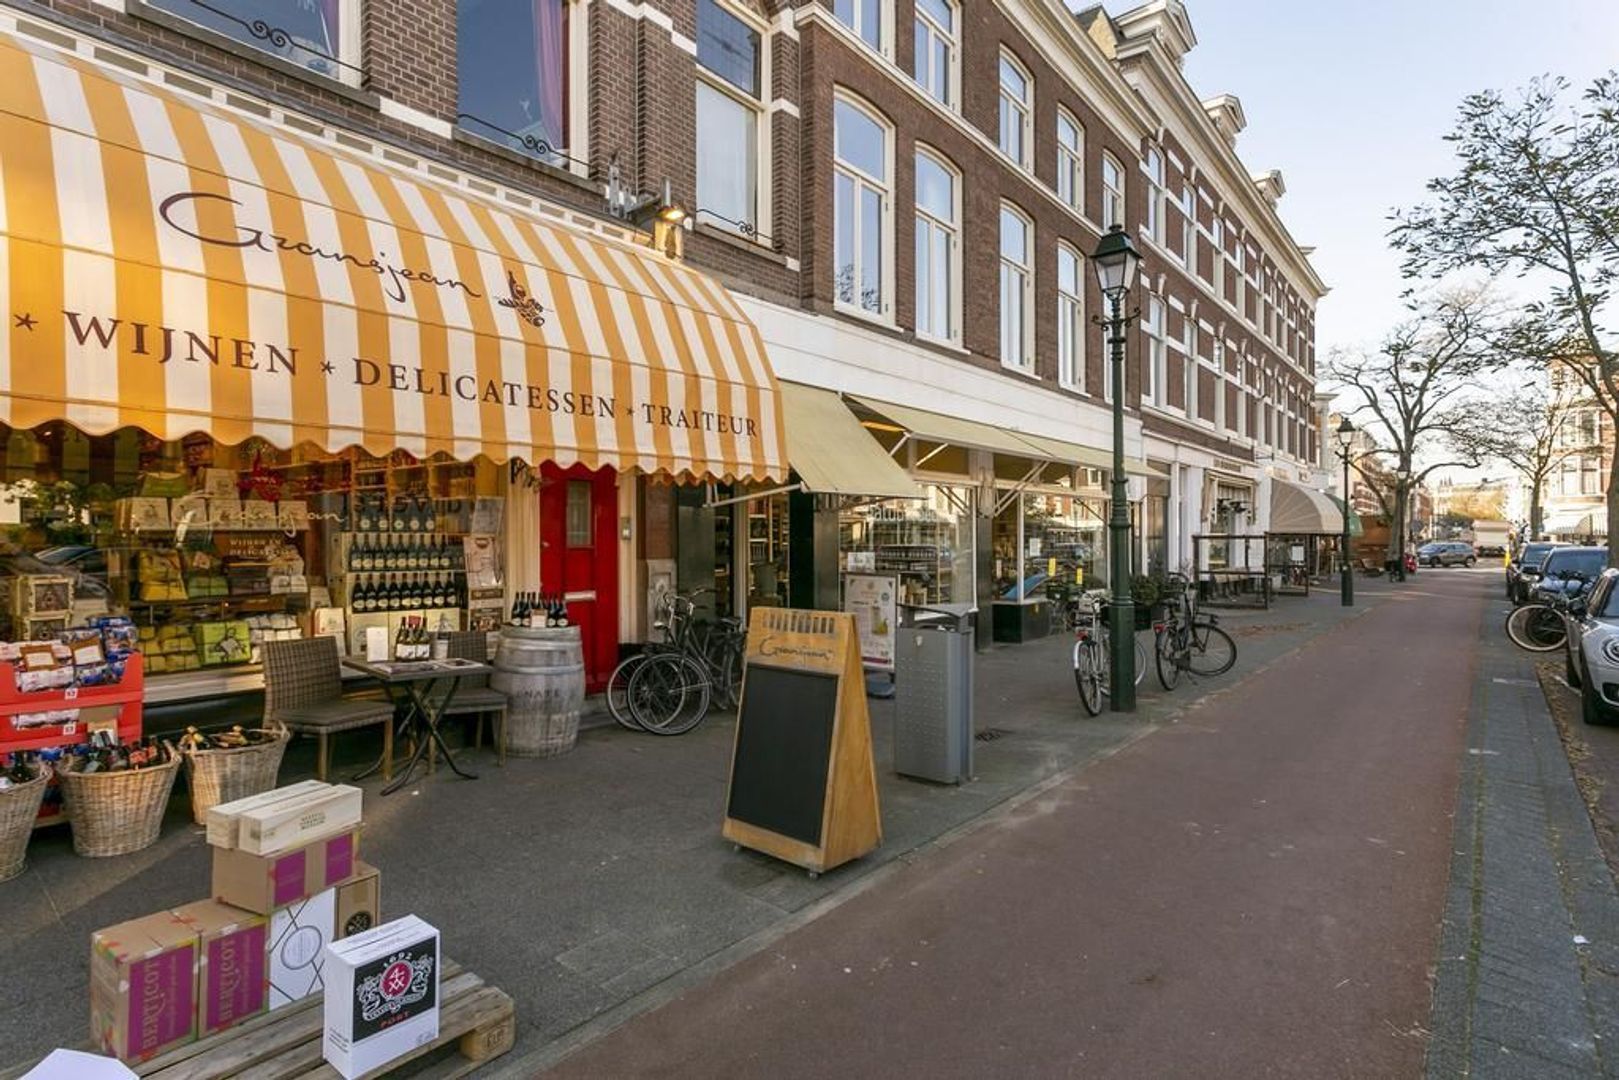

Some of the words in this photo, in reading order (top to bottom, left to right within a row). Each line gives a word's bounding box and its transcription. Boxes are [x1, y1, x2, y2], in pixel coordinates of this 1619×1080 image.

[61, 310, 300, 376] WIJNEN
[352, 356, 617, 419] DELICATESSEN
[642, 402, 758, 438] TRAITEUR
